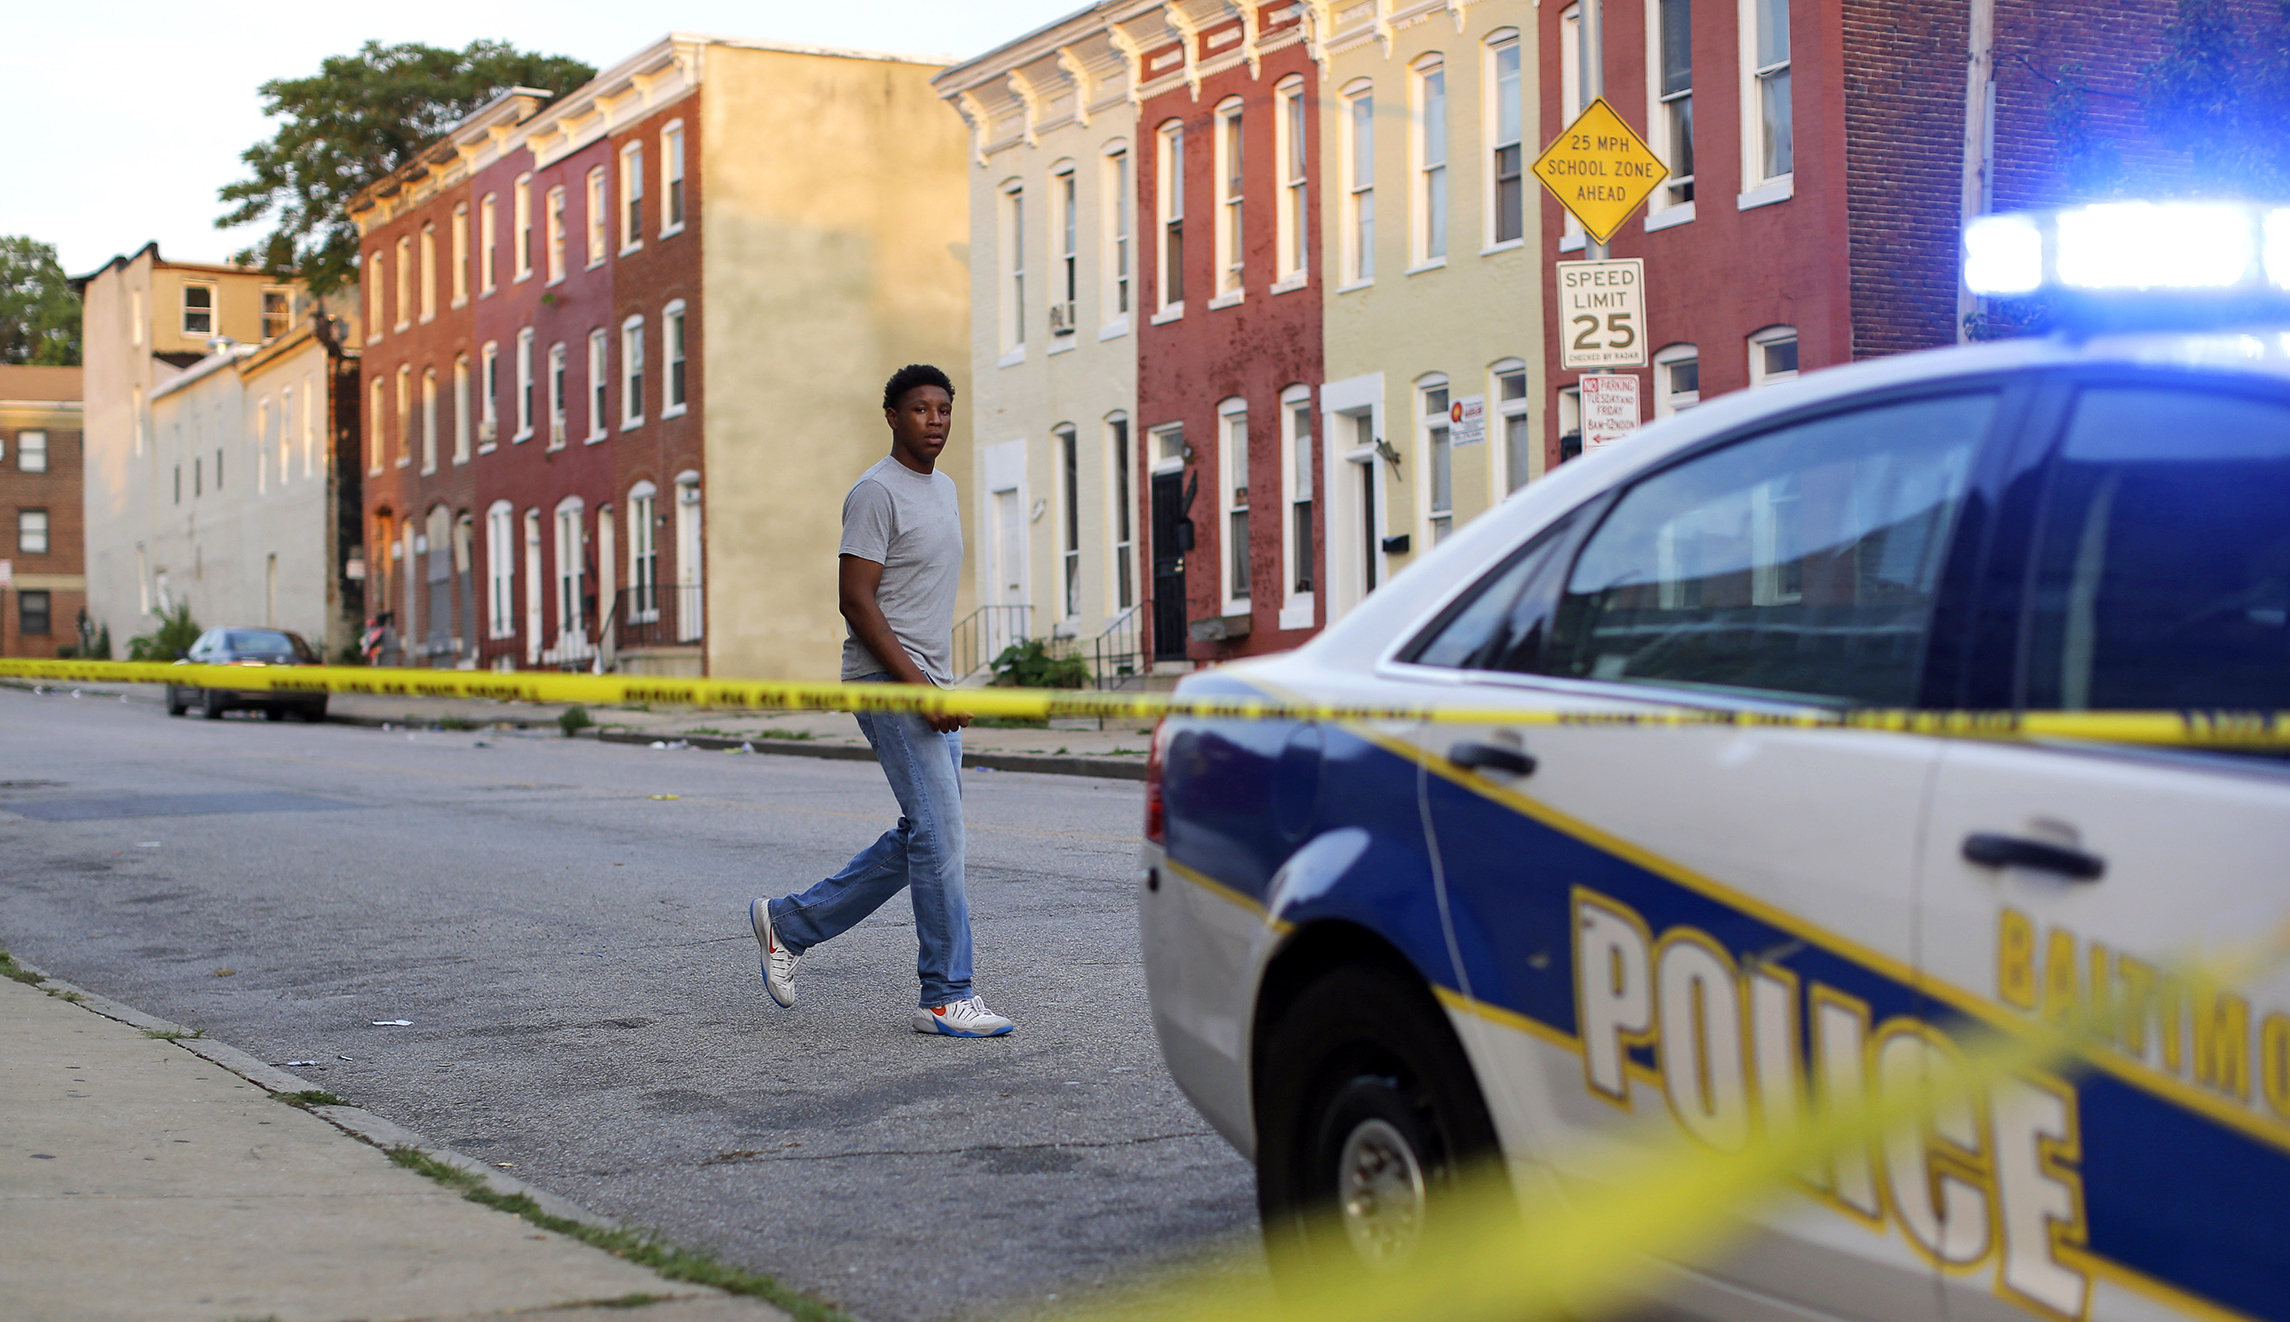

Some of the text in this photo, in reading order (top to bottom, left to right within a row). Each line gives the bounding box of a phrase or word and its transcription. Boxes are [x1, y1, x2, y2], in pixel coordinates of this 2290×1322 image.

[1572, 135, 1630, 152] 25 MPH
[1548, 159, 1654, 178] SCHOOL ZONE
[1577, 186, 1626, 201] AHEAD
[1566, 270, 1634, 287] SPEED
[1574, 292, 1627, 308] LIMIT
[1573, 313, 1635, 350] 25
[1569, 351, 1640, 362] CHECKED BY RADAR
[1584, 378, 1635, 392] NO PARKING
[1587, 393, 1620, 404] TUESDAY
[1597, 405, 1624, 416] FRIDAY
[1570, 883, 2091, 1322] POLICE
